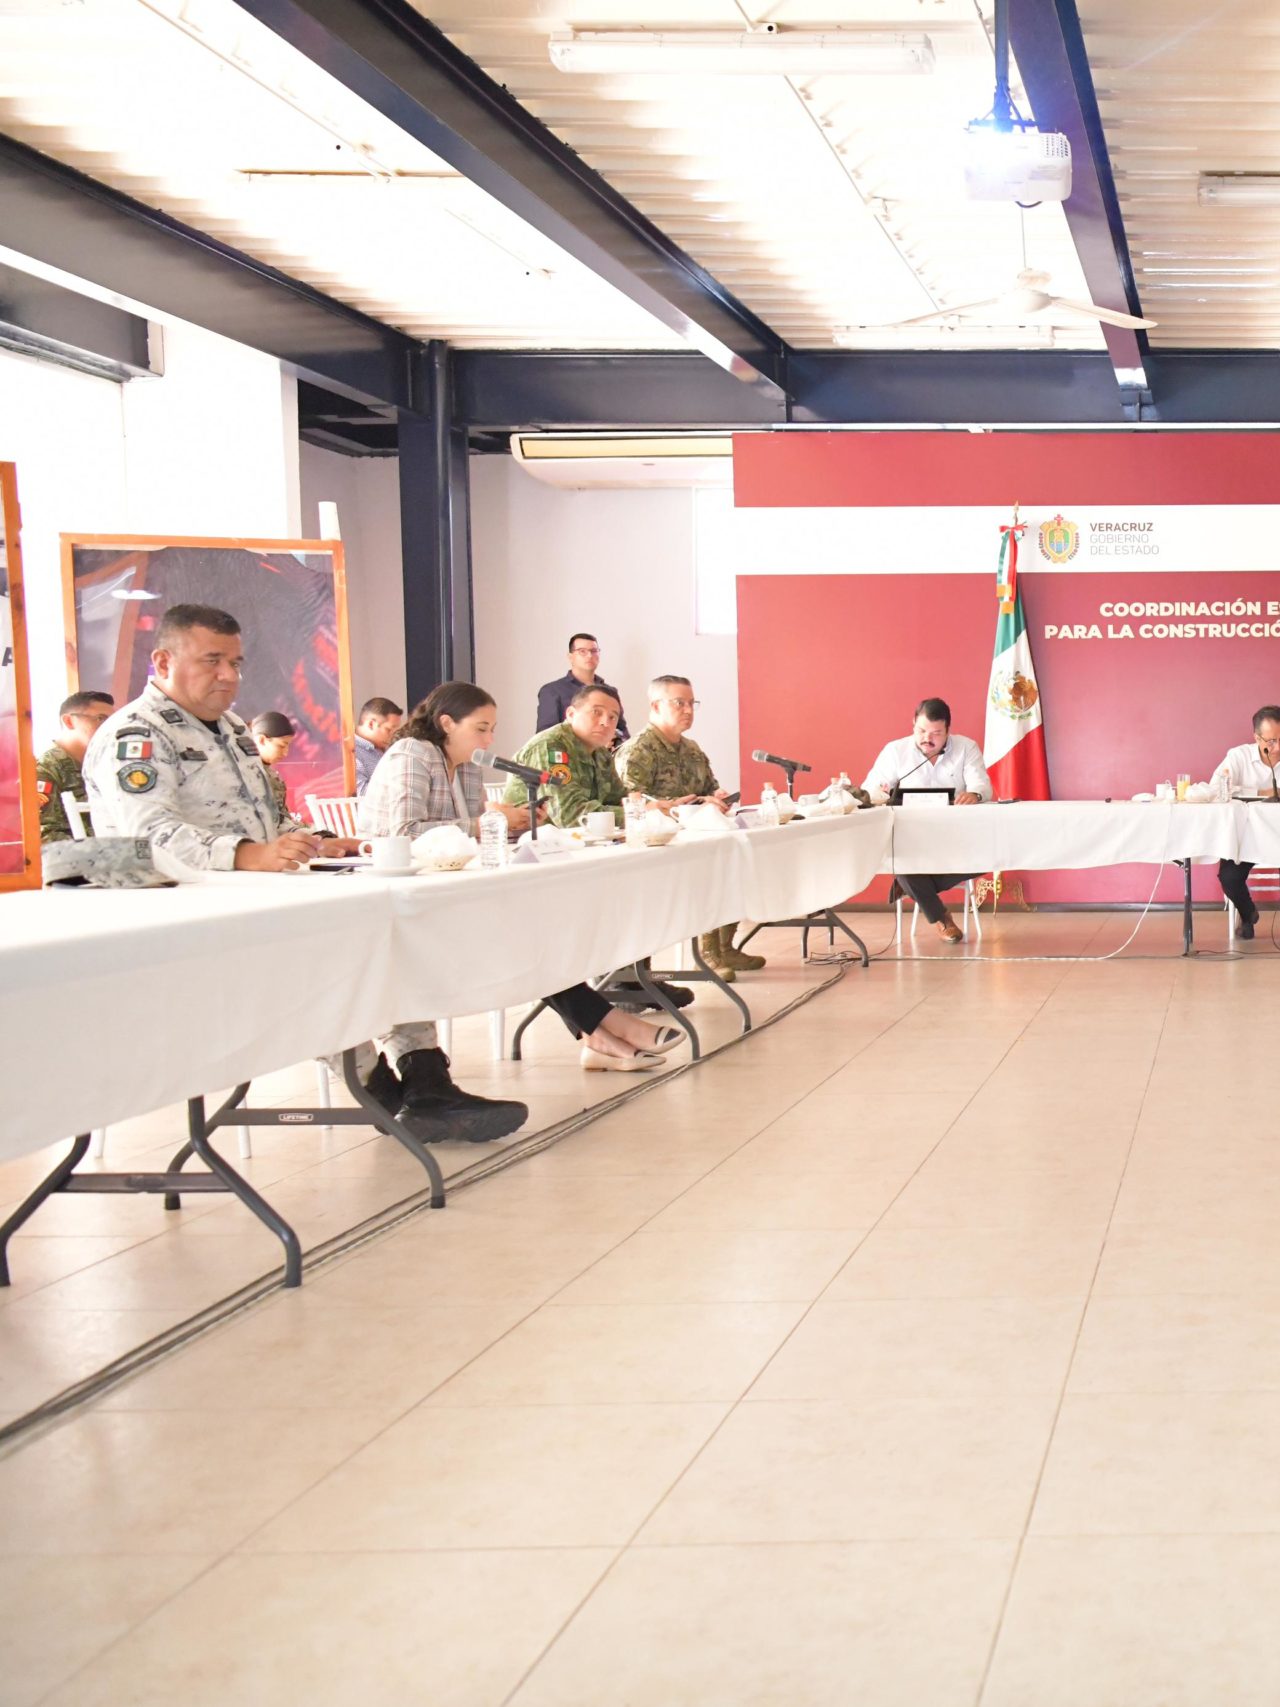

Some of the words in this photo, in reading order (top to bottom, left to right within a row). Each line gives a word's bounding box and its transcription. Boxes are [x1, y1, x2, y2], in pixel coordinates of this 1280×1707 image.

[1089, 522, 1154, 532] VERACRUZ
[1089, 533, 1150, 544] GOBIERNO
[1090, 545, 1112, 555] DEL
[1114, 545, 1160, 555] ESTADO
[1099, 598, 1261, 617] COORDINACIÓN
[1044, 624, 1103, 639] PARA
[1107, 624, 1135, 639] LA
